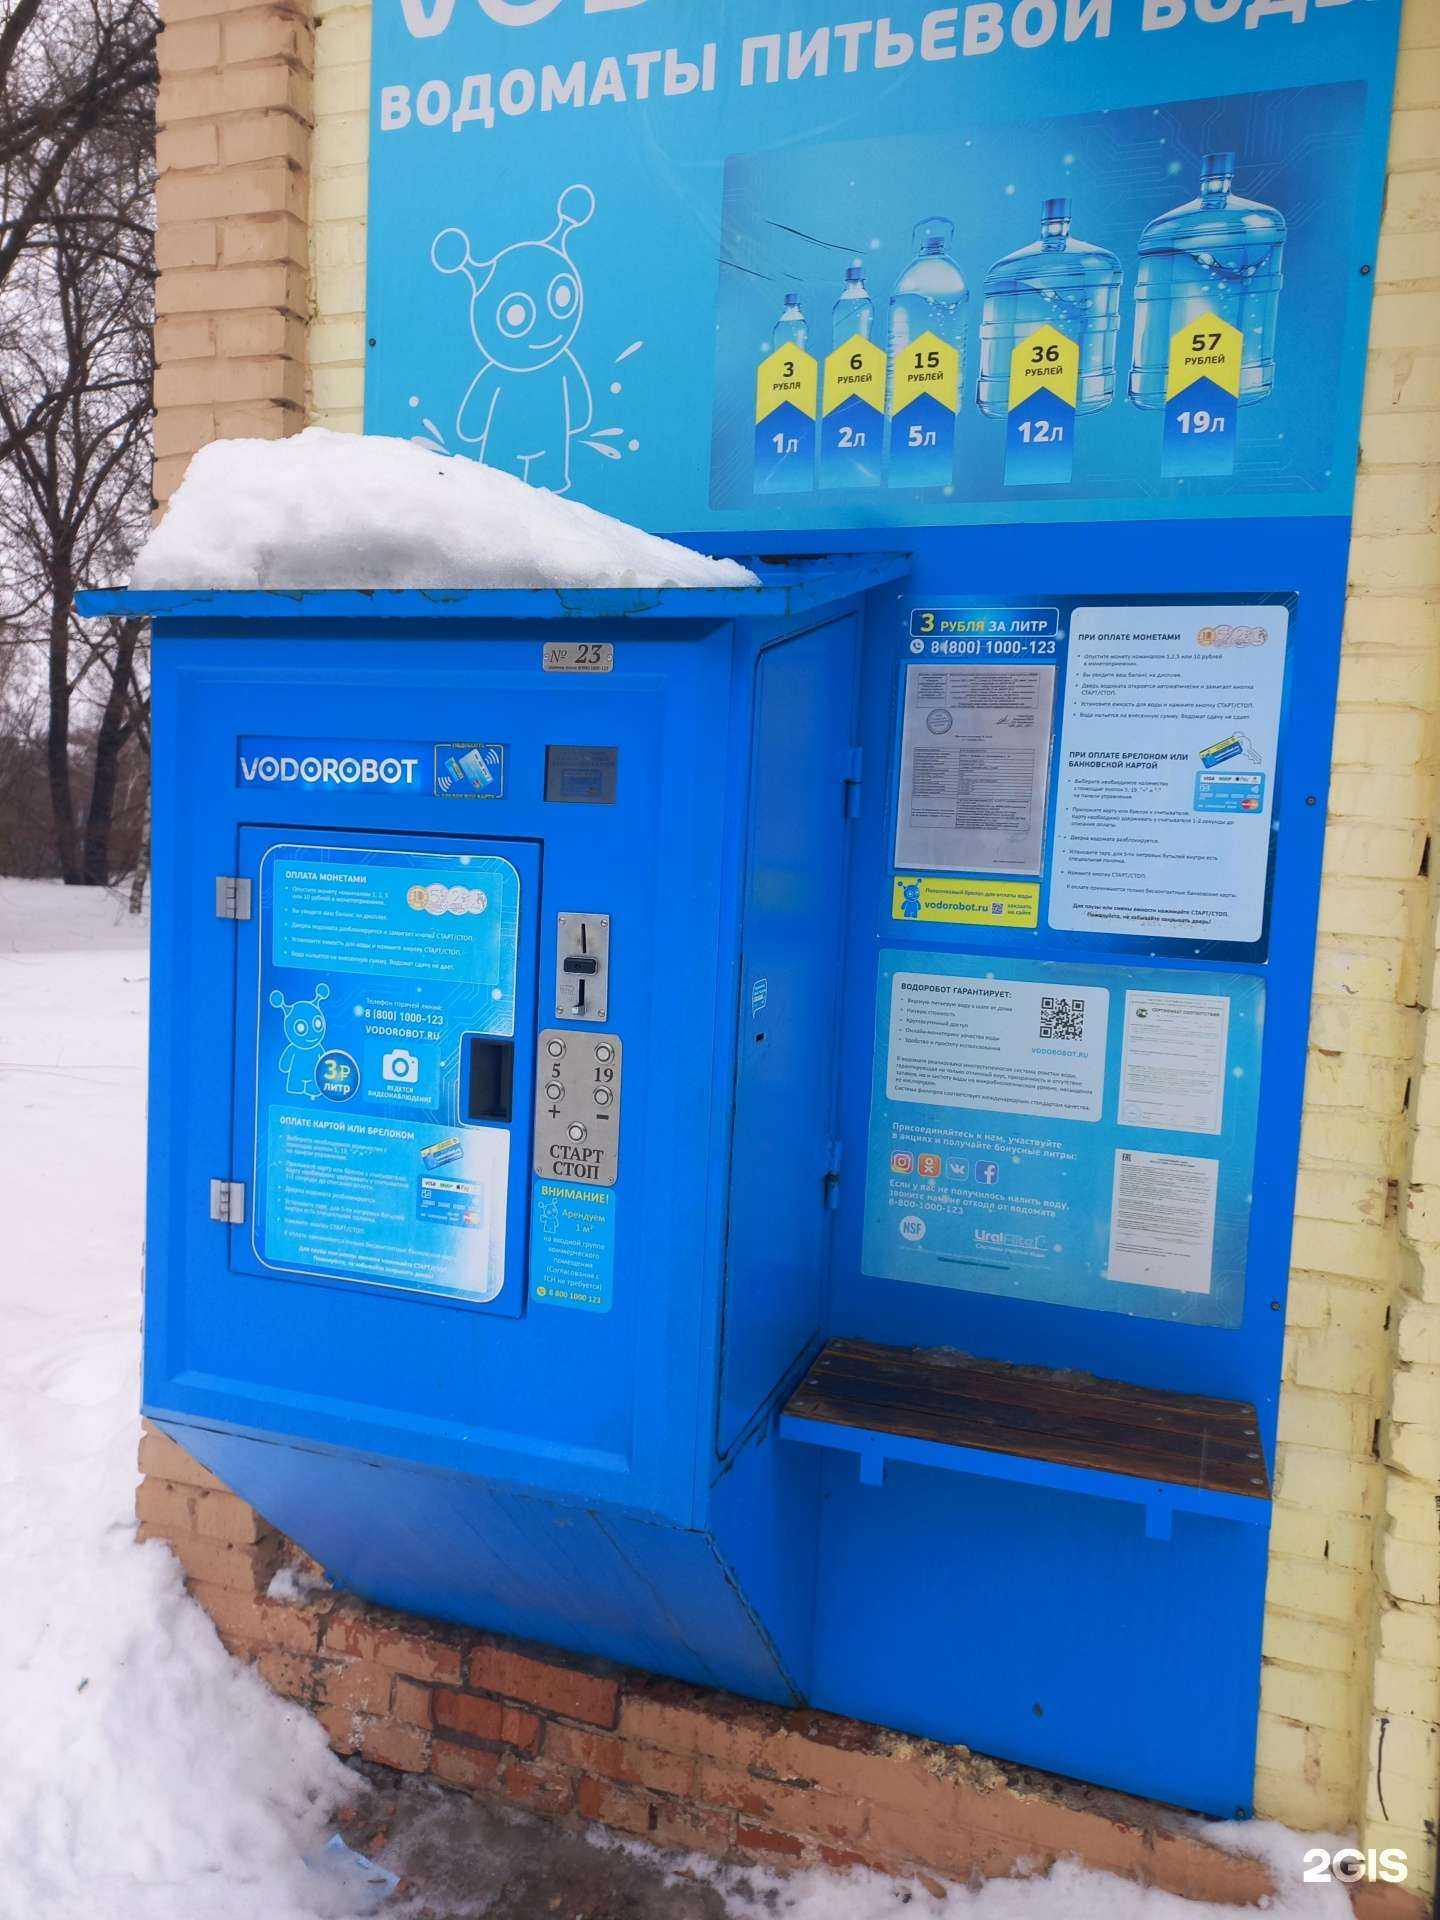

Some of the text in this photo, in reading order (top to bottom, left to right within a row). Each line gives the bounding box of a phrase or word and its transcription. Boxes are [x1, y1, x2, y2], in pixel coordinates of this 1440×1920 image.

[380, 43, 717, 132] ВОДОМАТЫ
[740, 0, 1112, 87] ПИТЬЕВОЙ
[1192, 333, 1222, 352] 57
[850, 354, 862, 370] 6
[914, 352, 939, 369] 15
[1031, 345, 1059, 363] 36
[1185, 354, 1225, 366] РУБЛЕЙ
[783, 362, 794, 377] 3
[908, 371, 944, 382] РУБЛЕЙ
[1025, 366, 1063, 376] РУБЛЕЙ
[773, 382, 801, 391] РУБЛЯ
[838, 373, 872, 384] РУБЛЕЙ
[1176, 411, 1225, 434] 19л
[838, 427, 866, 448] 2л
[908, 425, 937, 447] 5л
[1018, 420, 1063, 443] 12л
[772, 433, 798, 454] 1л
[920, 612, 1048, 633] 3 РУБЛЯ ЗА ЛИТР
[1078, 633, 1182, 642] ПРИ ОПЛАТЕ МОНЕТАМИ
[574, 643, 602, 664] 23
[986, 641, 1056, 656] 1000-123
[1068, 759, 1158, 770] БАНКОВСКОЙ КАРТОЙ
[1069, 751, 1188, 762] ПРИ ОПЛАТЕ БРЕЛОКОМ ИЛИ
[240, 756, 418, 785] VODOROBOT
[285, 870, 367, 885] ОПЛАТА МОНЕТАМИ
[924, 899, 988, 913] vodorobot.ru
[901, 982, 1013, 1000] ВОДОРОБОТ ГАРАНТИРУЕТ:
[365, 1008, 444, 1025] 8 (800) 1000-123
[365, 1025, 440, 1041] VODOROBOT.RU
[1031, 1047, 1088, 1059] VODOROBOT.RU
[551, 1062, 561, 1079] 5
[593, 1066, 614, 1083] 19
[280, 1116, 414, 1141] ОПЛАТЕ КАРТОЙ ИЛИ БРЕЛОКОМ
[892, 1122, 974, 1139] Присоединяйтесь
[1008, 1136, 1062, 1150] участвуйте
[899, 1133, 932, 1144] акциях
[944, 1138, 992, 1151] получайте
[994, 1142, 1041, 1156] бонусные
[550, 1144, 604, 1164] СТАРТ
[552, 1160, 600, 1180] СТОП
[541, 1185, 609, 1205] ВНИМАНИЕ!
[890, 1179, 910, 1189] Если
[938, 1186, 948, 1194] не
[951, 1187, 1004, 1202] получилось
[561, 1208, 606, 1223] Арендуем
[903, 1222, 922, 1234] NSF
